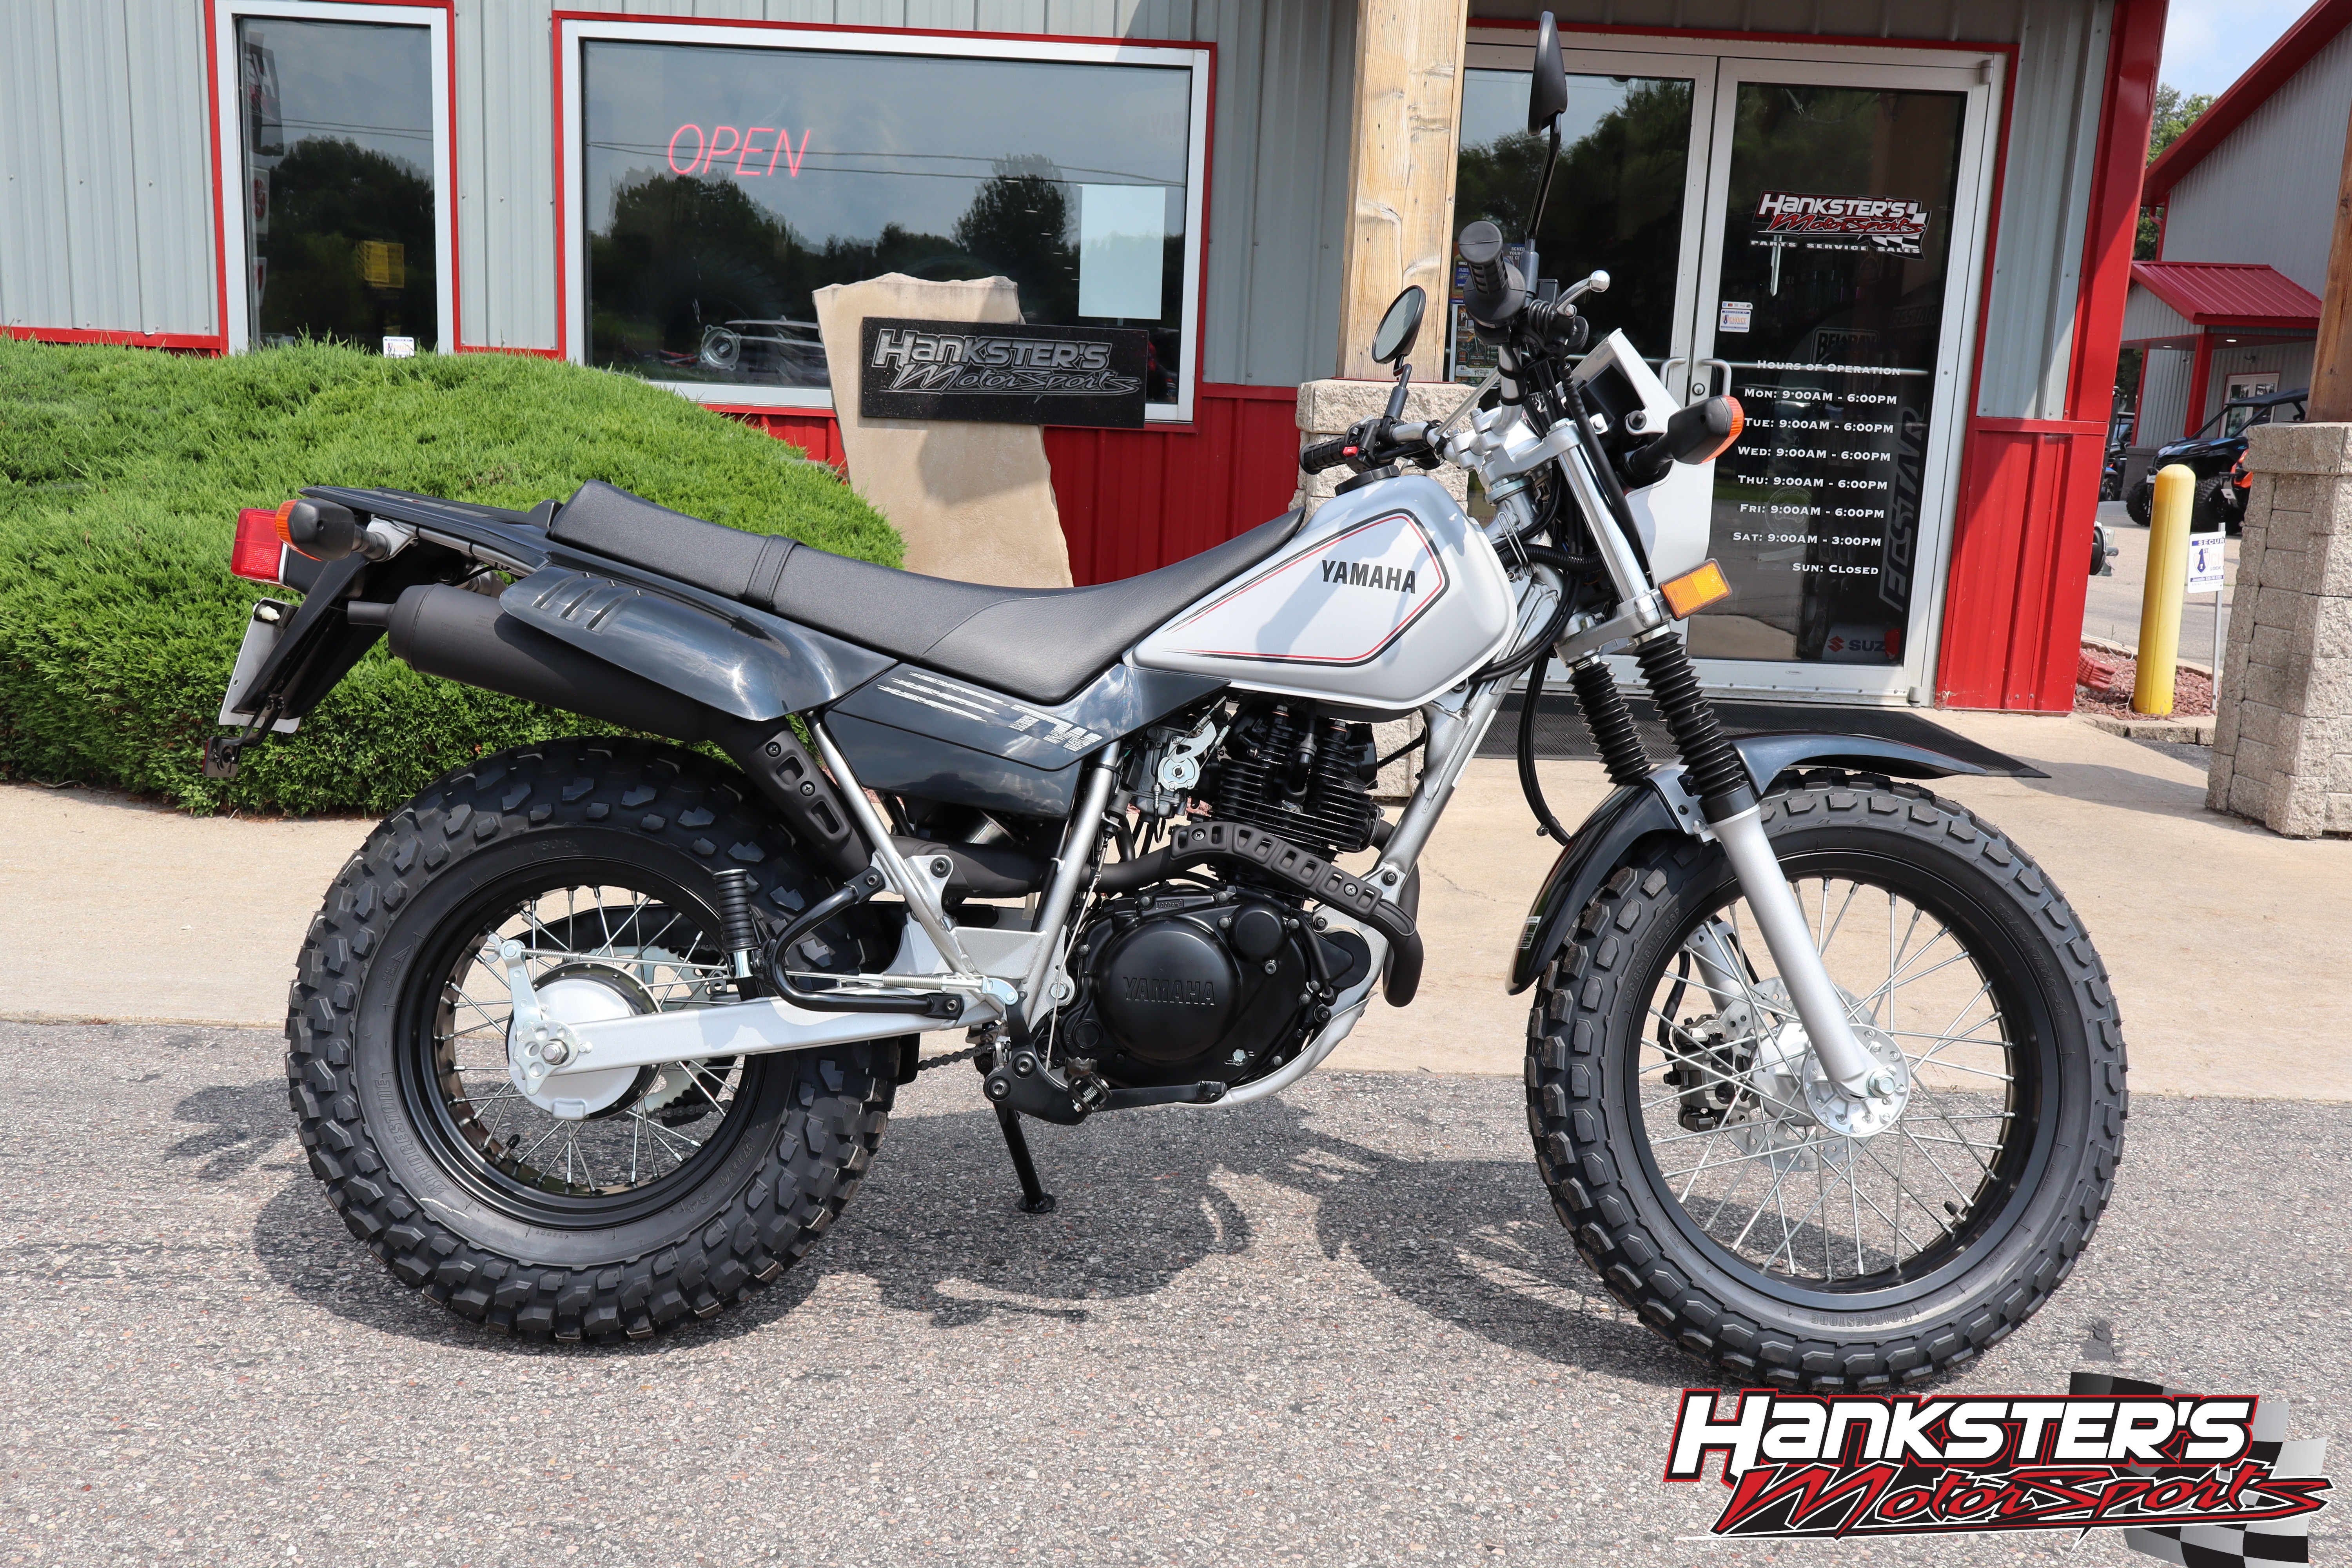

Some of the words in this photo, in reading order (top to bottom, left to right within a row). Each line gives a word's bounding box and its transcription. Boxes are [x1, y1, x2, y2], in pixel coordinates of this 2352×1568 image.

[668, 124, 811, 177] OPEN
[1806, 243, 1868, 251] SERVICE
[1757, 360, 1800, 371] HOURS
[1805, 363, 1822, 372] OF
[1827, 363, 1901, 376] OPERATION
[1744, 388, 1777, 398] MON:
[1781, 390, 1833, 402] 9:00AM
[1847, 394, 1897, 405] 6:00PM
[1744, 417, 1774, 427] TUE:
[1779, 419, 1829, 430] 9:00AM
[1844, 423, 1894, 433] 6:00PM
[1738, 446, 1771, 456] WED:
[1776, 448, 1827, 459] 9:00AM
[1841, 451, 1891, 461] 6:00PM
[1738, 475, 1768, 485] THU:
[1773, 477, 1824, 487] 9:00AM
[1838, 480, 1887, 490] 6:00PM
[1740, 504, 1765, 513] FRI:
[1770, 505, 1820, 515] 9:00AM
[1835, 508, 1884, 518] 6:00PM
[1733, 532, 1762, 541] SAT:
[1768, 534, 1818, 544] 9:00AM
[1831, 536, 1881, 546] 3:00PM
[1321, 559, 1416, 594] YAMAHA
[1792, 563, 1823, 572] SUN:
[1829, 564, 1878, 574] CLOSED
[1122, 976, 1216, 1006] YAMAHA
[374, 1078, 450, 1197] BRIDGESTONE
[1811, 1308, 1913, 1327] BRIDGESTONE
